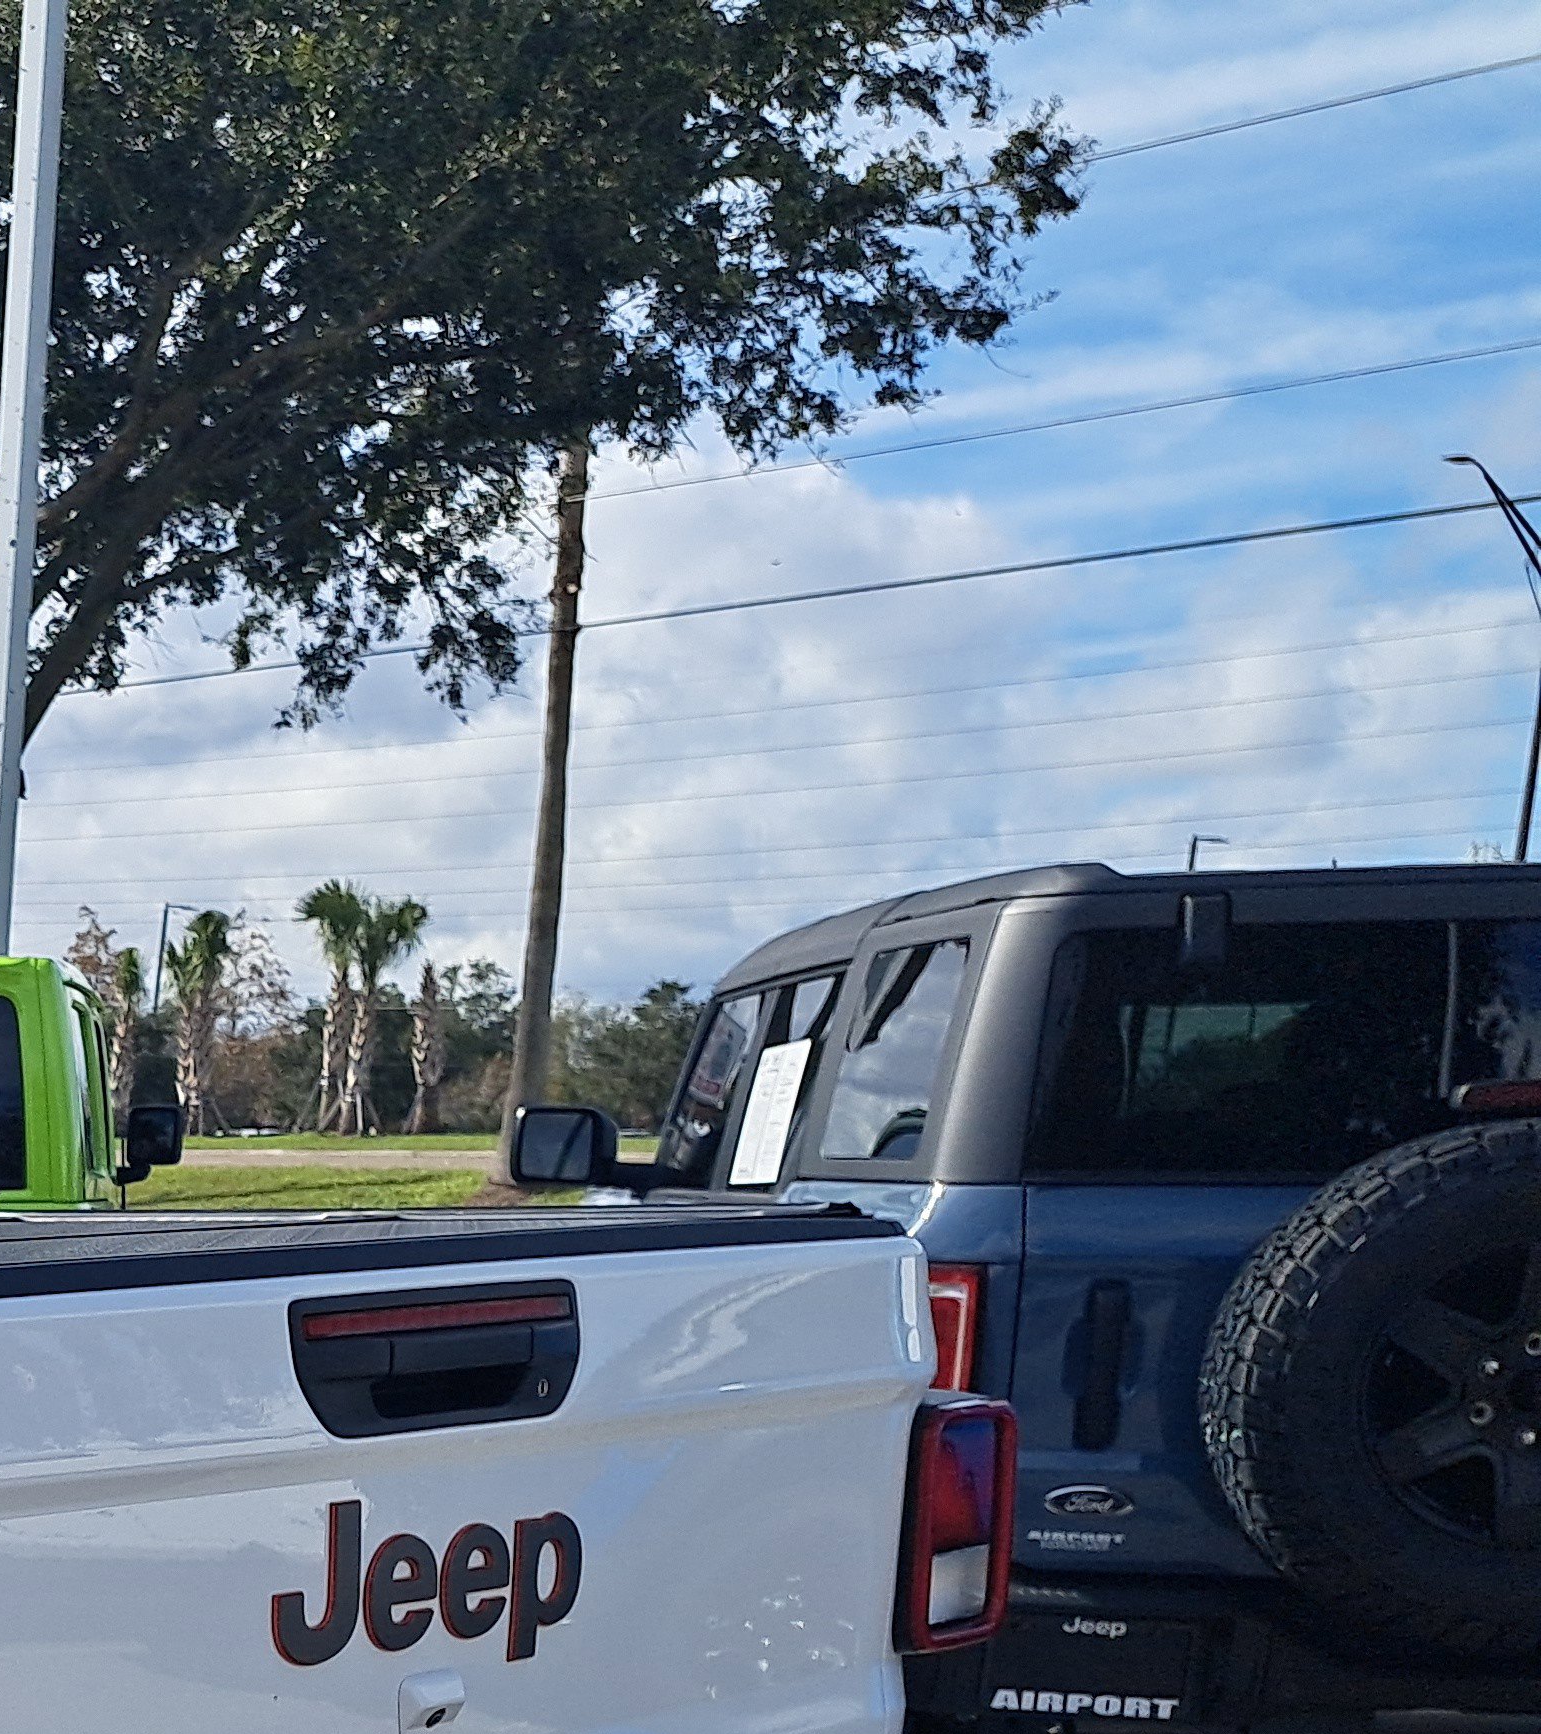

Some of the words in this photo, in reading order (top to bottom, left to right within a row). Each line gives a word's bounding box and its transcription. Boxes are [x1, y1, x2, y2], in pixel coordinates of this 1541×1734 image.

[1063, 1493, 1115, 1514] Ford
[272, 1499, 584, 1667] Jeep
[1061, 1616, 1128, 1639] Jeep
[990, 1688, 1180, 1720] AIRPORT
